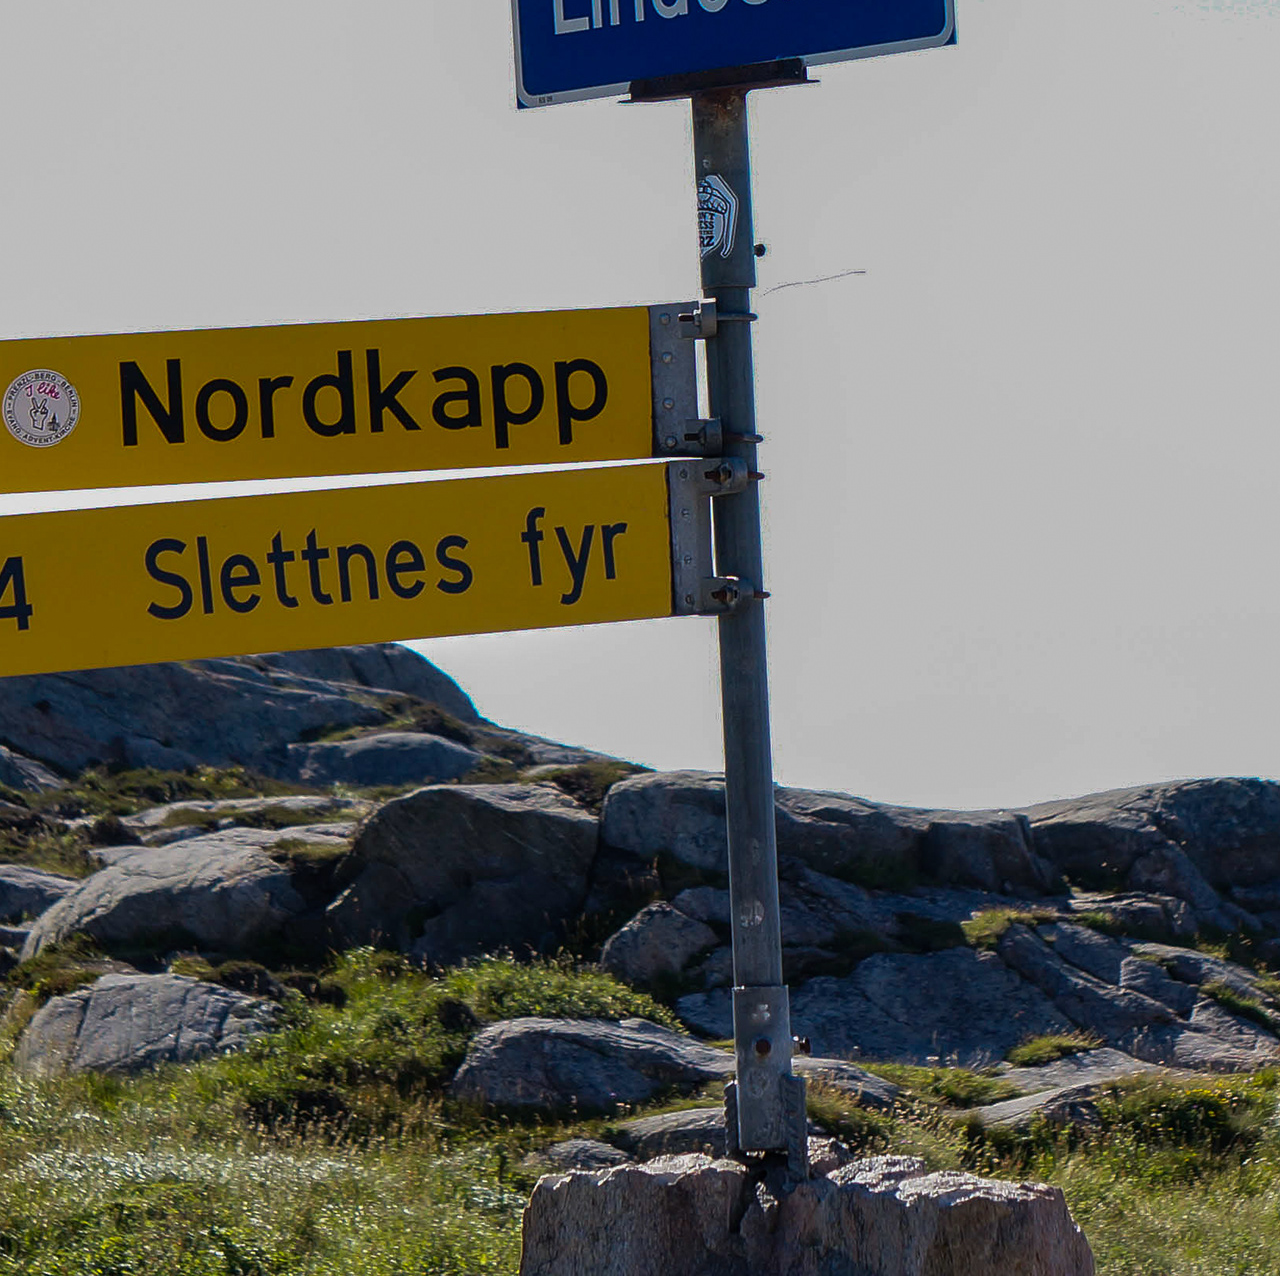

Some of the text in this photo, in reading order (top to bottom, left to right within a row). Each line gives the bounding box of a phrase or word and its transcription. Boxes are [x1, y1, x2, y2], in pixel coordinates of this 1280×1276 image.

[37, 382, 60, 399] like
[120, 349, 609, 449] Nordkapp
[145, 527, 474, 621] Slettnes
[521, 507, 628, 607] fyr
